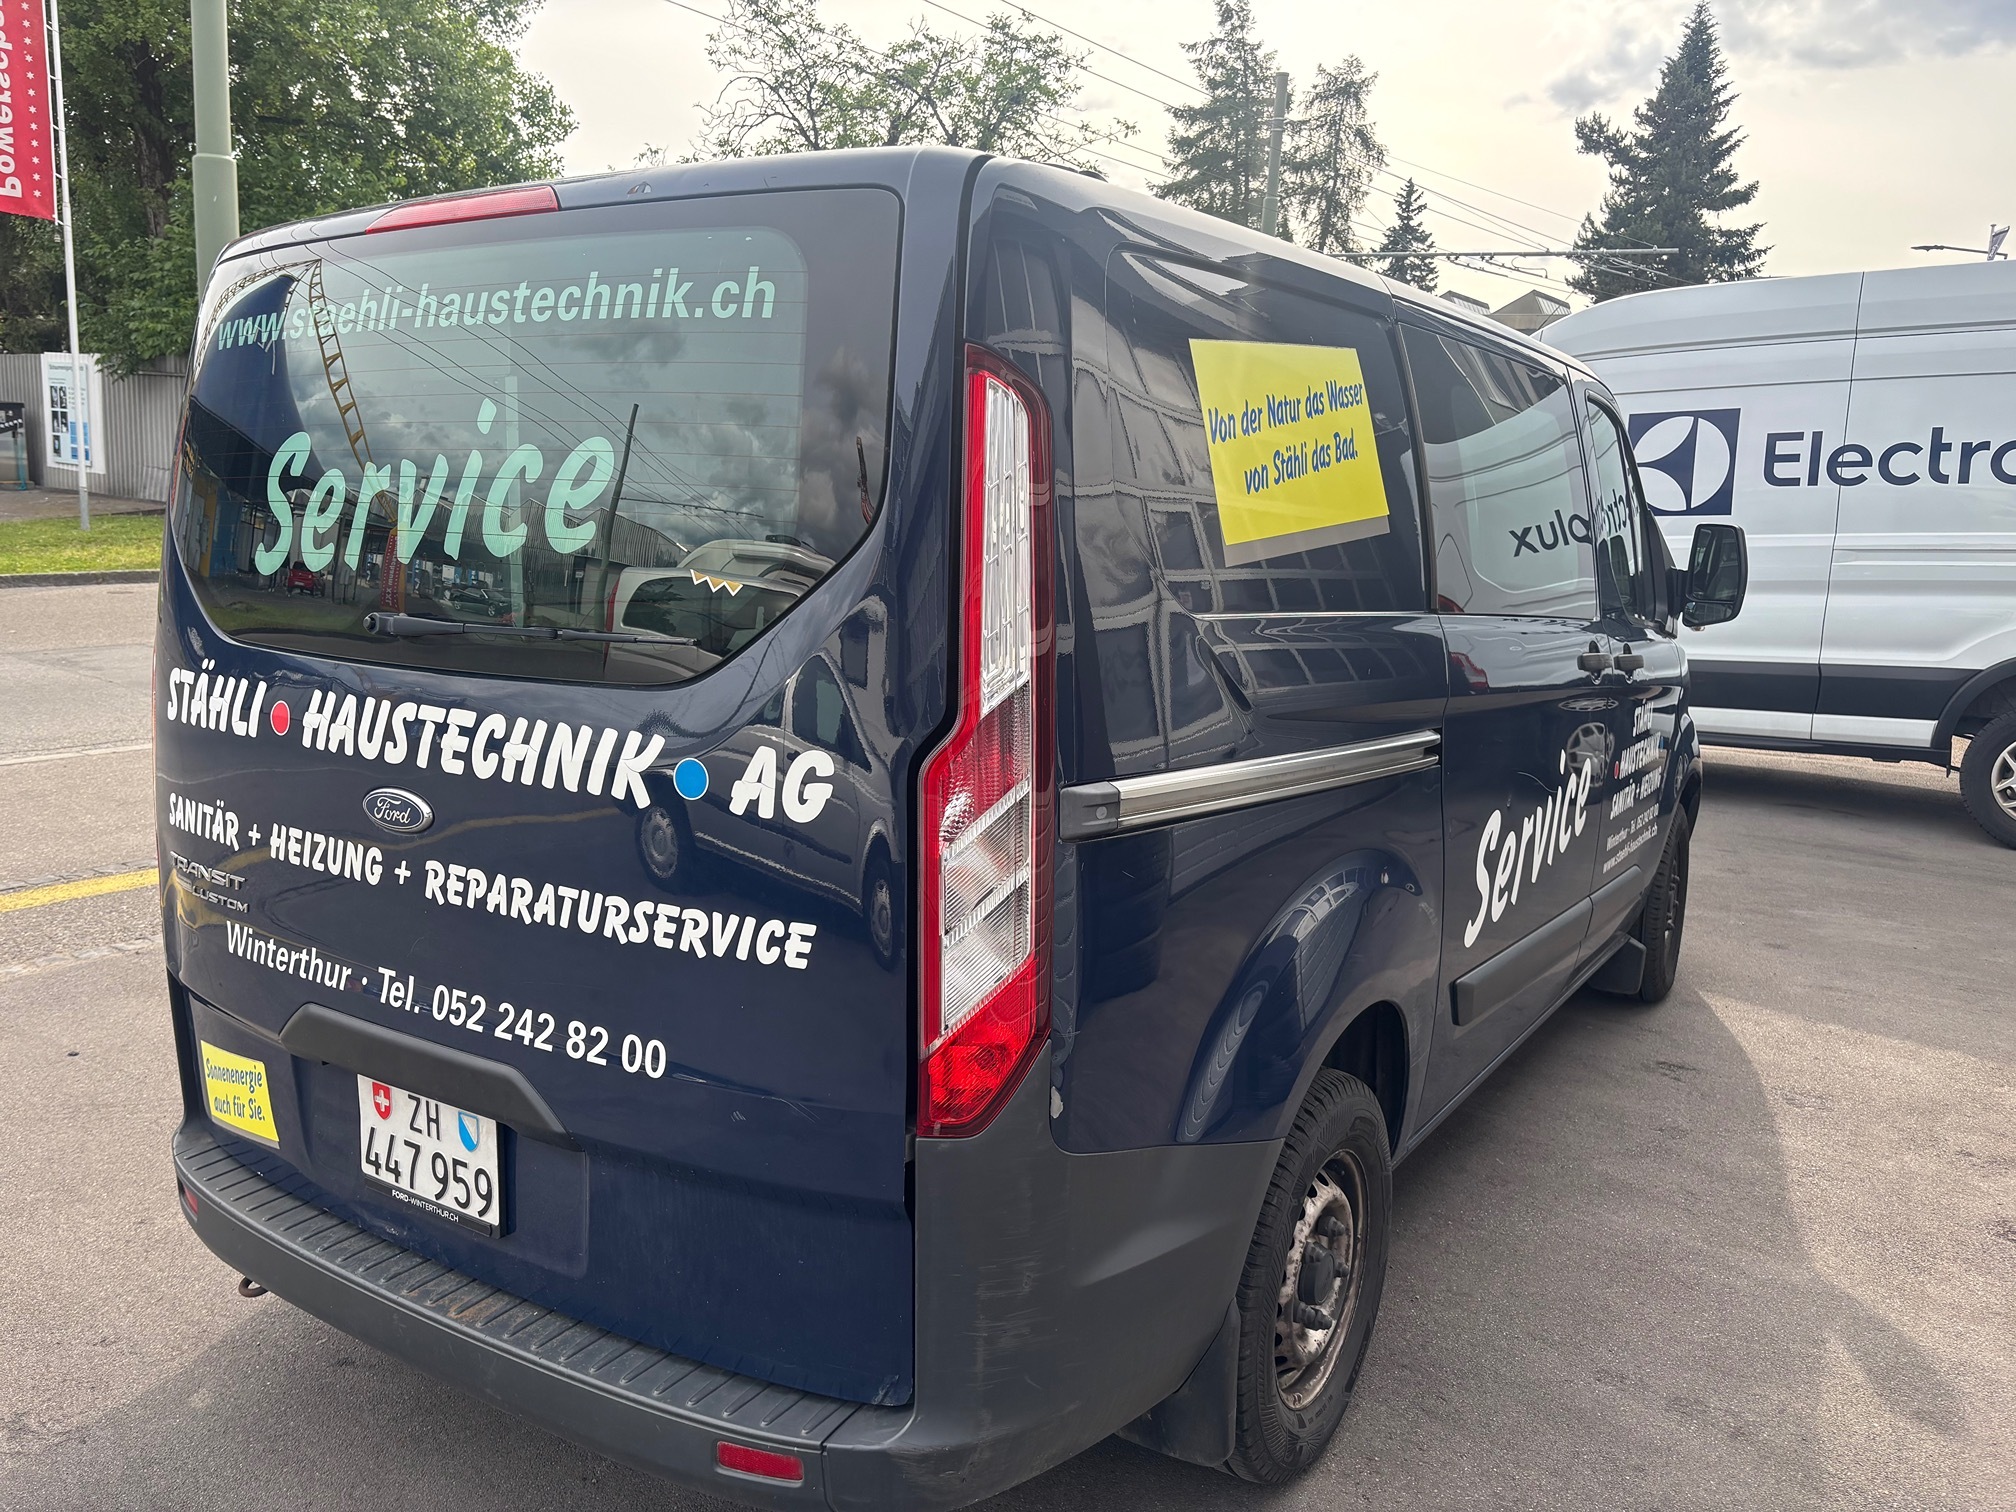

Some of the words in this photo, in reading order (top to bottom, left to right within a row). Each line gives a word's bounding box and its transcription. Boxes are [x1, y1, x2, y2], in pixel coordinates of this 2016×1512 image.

[217, 265, 776, 351] www.staehli-haustechnik.ch
[1208, 406, 1237, 445] Von
[1241, 399, 1263, 437] der
[1266, 393, 1302, 429] Natur
[1305, 384, 1325, 419] das
[1325, 379, 1363, 412] Wasser
[254, 397, 616, 577] Service
[1244, 462, 1269, 495] von
[1273, 440, 1308, 486] Stähli
[1311, 437, 1331, 473] das
[1333, 427, 1359, 464] Bad.
[167, 657, 268, 738] STÄHLI
[302, 688, 667, 810] HAUSTECHNIK
[728, 745, 835, 824] AG
[1619, 731, 1661, 780] HAUSTECHNIK
[373, 796, 412, 825] Ford
[1609, 778, 1636, 821] SANITÄR
[169, 850, 247, 891] TRANSIT
[1463, 748, 1592, 948] Service
[169, 791, 240, 852] SANITÄR
[247, 823, 261, 847] +
[269, 822, 384, 886] HEIZUNG
[393, 860, 412, 885] +
[424, 859, 818, 970] REPARATURSERVICE
[191, 885, 250, 914] CUSTOM
[226, 920, 353, 991] Winterthur
[377, 966, 421, 1014] Tel.
[431, 984, 488, 1034] 052
[494, 1002, 556, 1053] 242
[565, 1020, 610, 1067] 82
[621, 1033, 667, 1080] 00
[205, 1057, 263, 1094] Sonnenenergie
[213, 1093, 232, 1116] auch
[233, 1094, 246, 1119] für
[248, 1097, 266, 1122] Sie.
[407, 1093, 442, 1141] ZH
[365, 1126, 422, 1190] 447
[431, 1151, 493, 1218] 959
[391, 1189, 459, 1223] FORD-WINTERTHUR.CH
